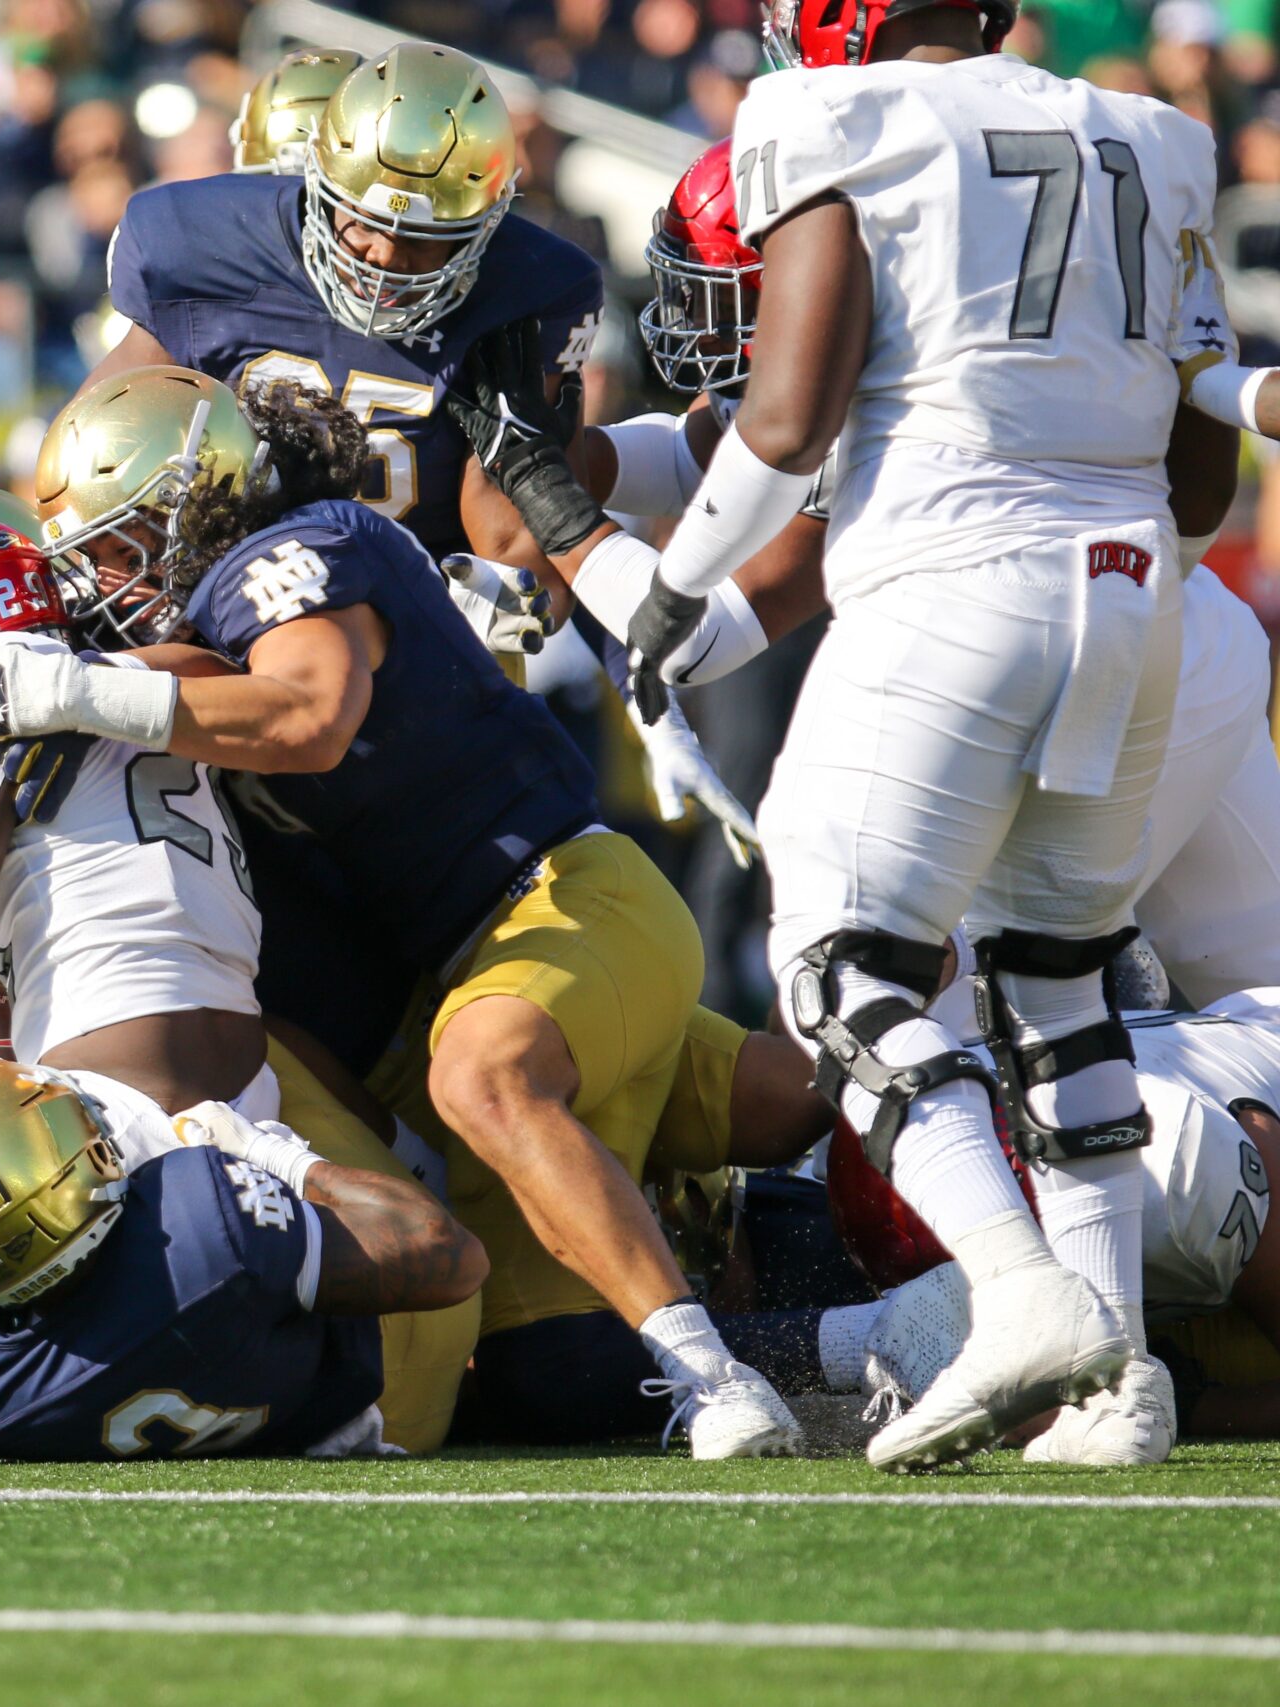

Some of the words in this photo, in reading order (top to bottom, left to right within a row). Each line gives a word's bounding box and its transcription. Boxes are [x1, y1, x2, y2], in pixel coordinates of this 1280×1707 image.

[736, 140, 780, 230] 71
[981, 128, 1150, 340] 71
[241, 539, 330, 625] ND
[1089, 541, 1153, 588] UNLV
